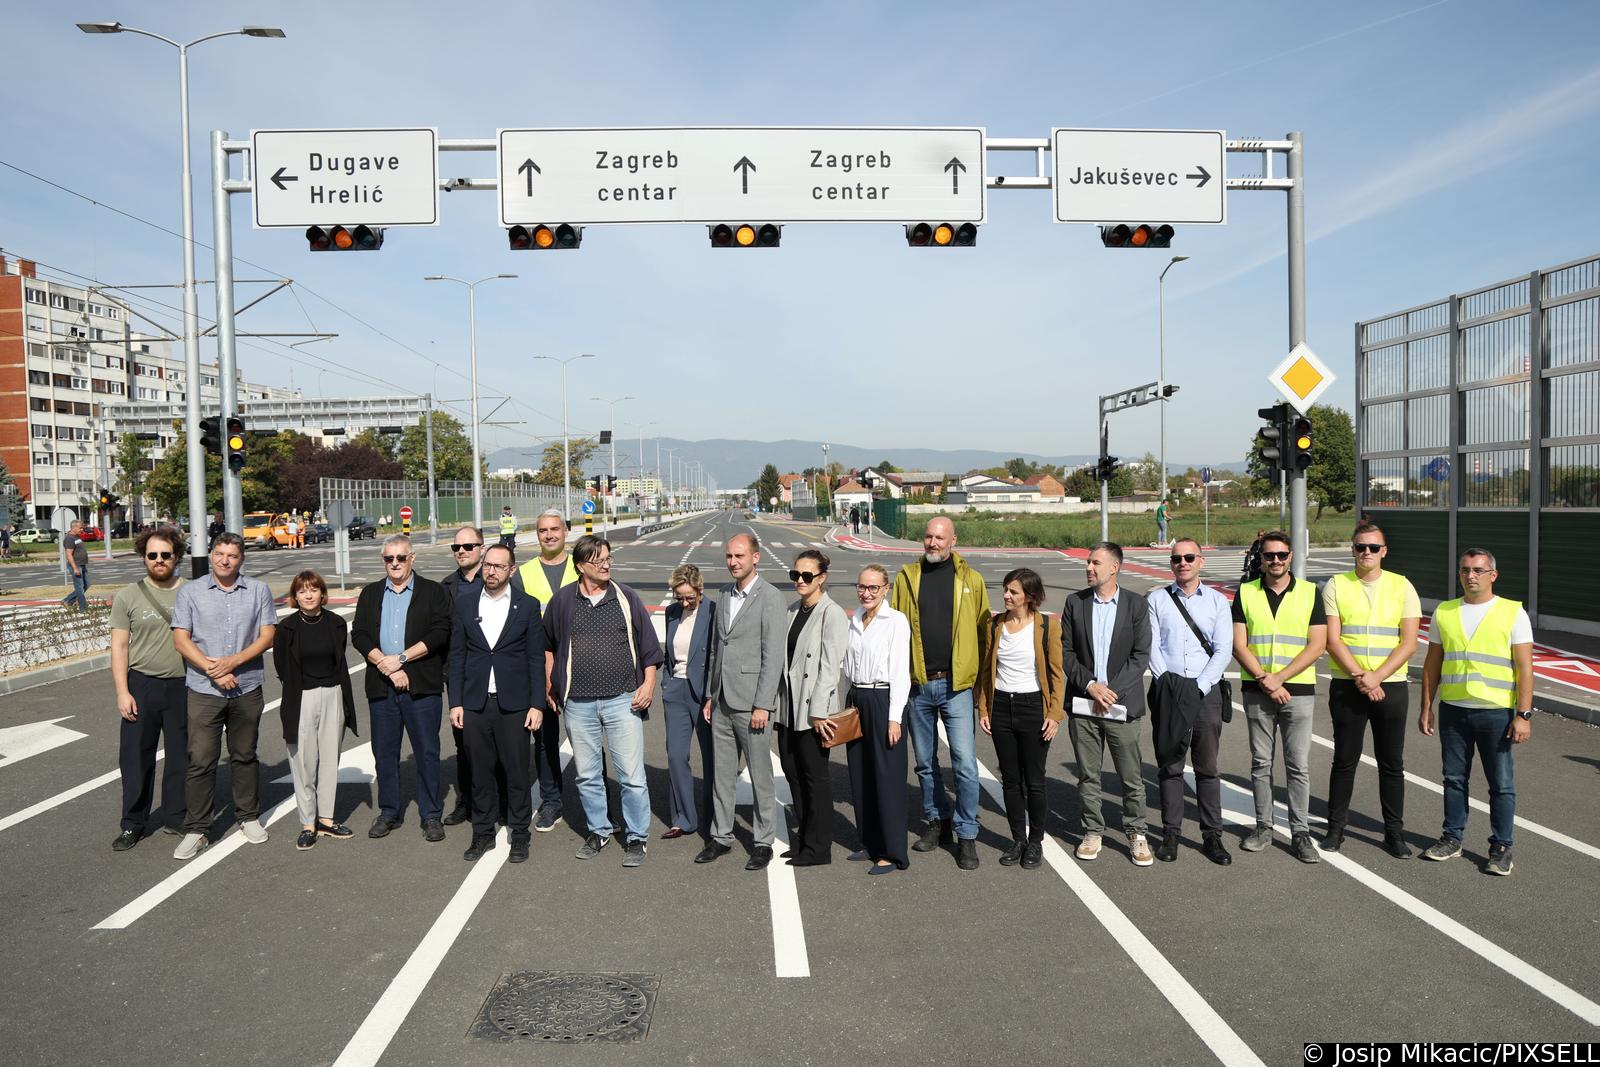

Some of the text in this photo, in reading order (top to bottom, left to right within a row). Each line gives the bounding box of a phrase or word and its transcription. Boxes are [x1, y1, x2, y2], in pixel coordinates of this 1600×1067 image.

[309, 152, 399, 176] Dugave
[596, 150, 678, 174] Zagreb
[810, 150, 892, 173] Zagreb
[1069, 166, 1179, 186] Jakuševec
[310, 184, 383, 204] Hrelić
[598, 183, 677, 202] centar
[812, 182, 890, 200] centar
